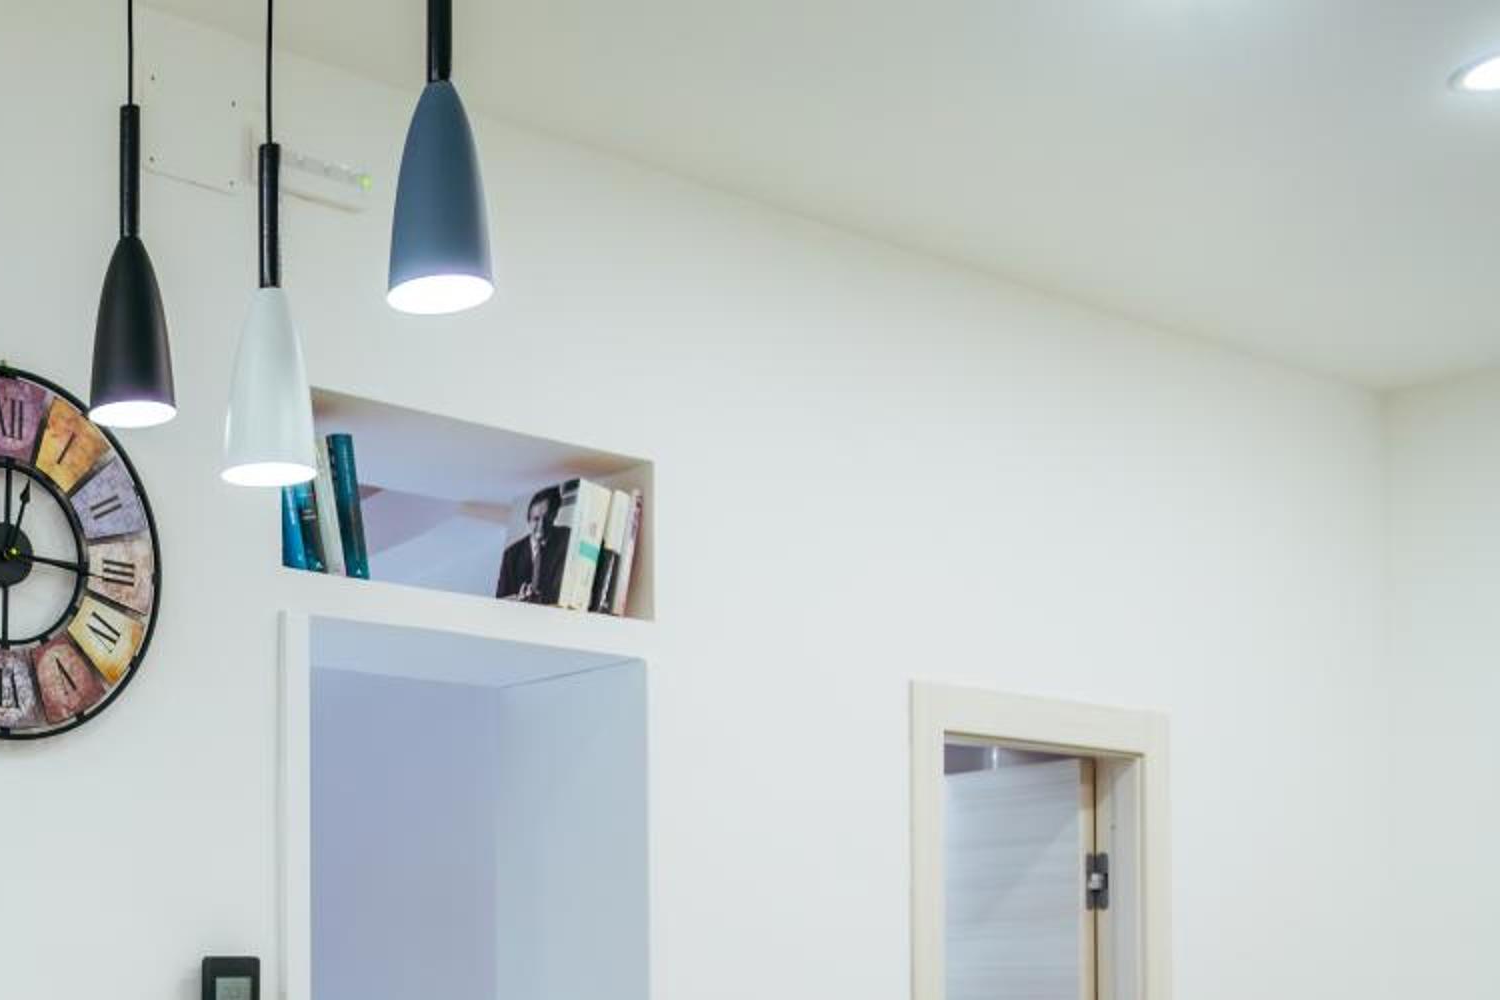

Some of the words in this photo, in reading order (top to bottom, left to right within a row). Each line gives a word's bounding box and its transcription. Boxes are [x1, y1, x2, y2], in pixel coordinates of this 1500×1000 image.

[56, 431, 76, 465] I
[89, 495, 123, 520] II
[102, 559, 136, 588] III
[85, 611, 121, 653] IV
[55, 656, 78, 695] V
